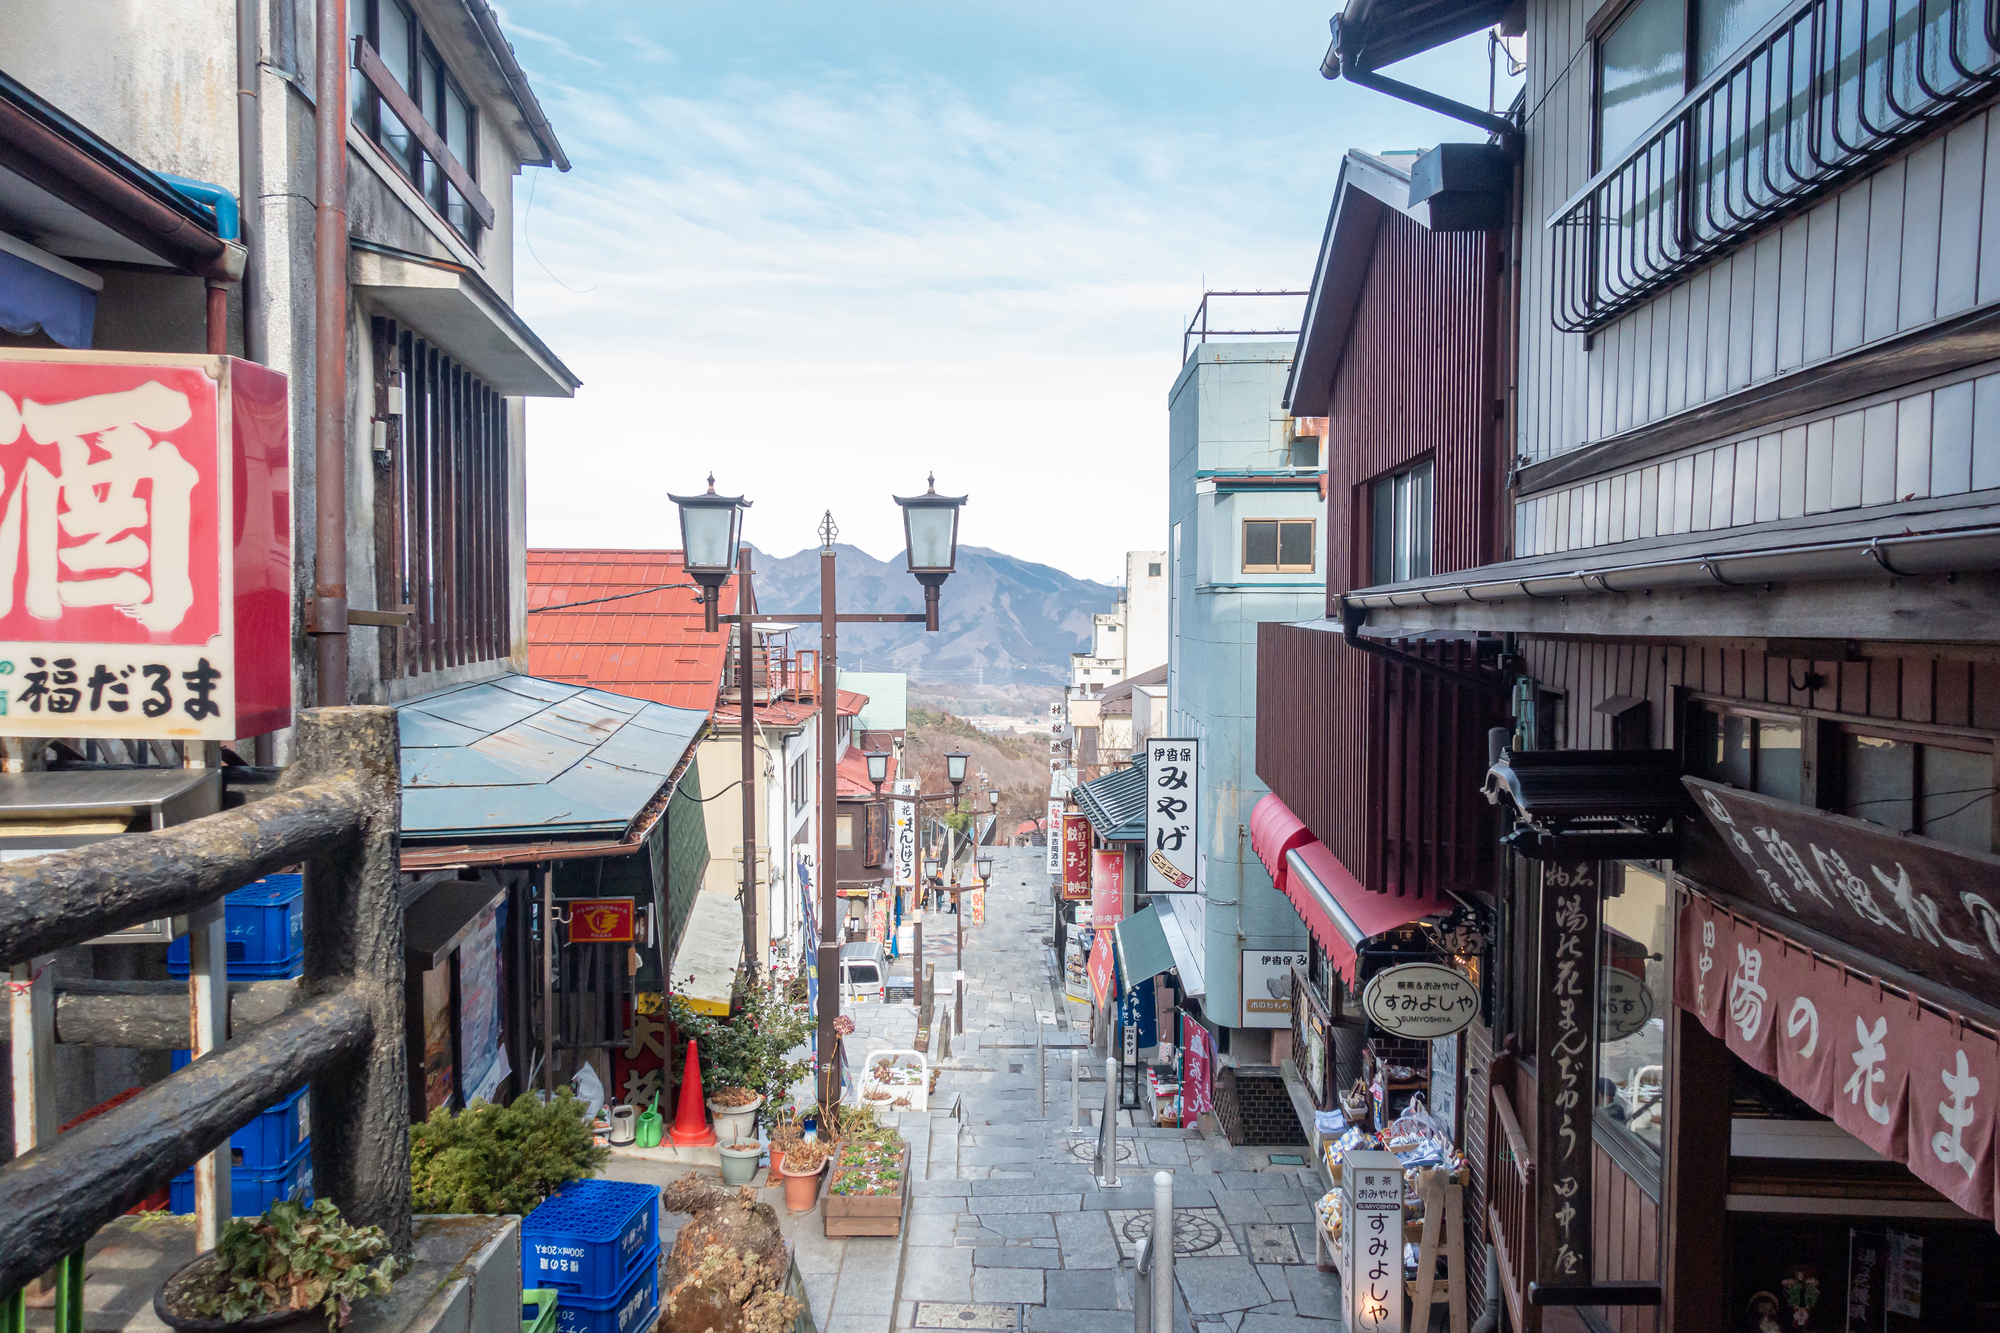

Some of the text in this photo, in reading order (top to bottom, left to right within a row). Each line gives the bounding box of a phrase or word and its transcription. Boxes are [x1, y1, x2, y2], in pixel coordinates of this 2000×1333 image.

[16, 657, 222, 721] 福だるま
[1154, 748, 1191, 762] 伊香保
[1157, 766, 1190, 851] みやげ
[900, 816, 914, 879] まんじゅう
[1066, 826, 1078, 868] 餃子
[1077, 821, 1087, 878] 手打ラーメン
[1095, 914, 1122, 923] 中央亭
[1383, 994, 1474, 1013] すみよしや
[1401, 1015, 1452, 1023] SUMIYOSHIYA
[1358, 1189, 1399, 1200] おみやげ
[1364, 1176, 1392, 1186] 喫茶
[1367, 1212, 1390, 1325] すみよしや
